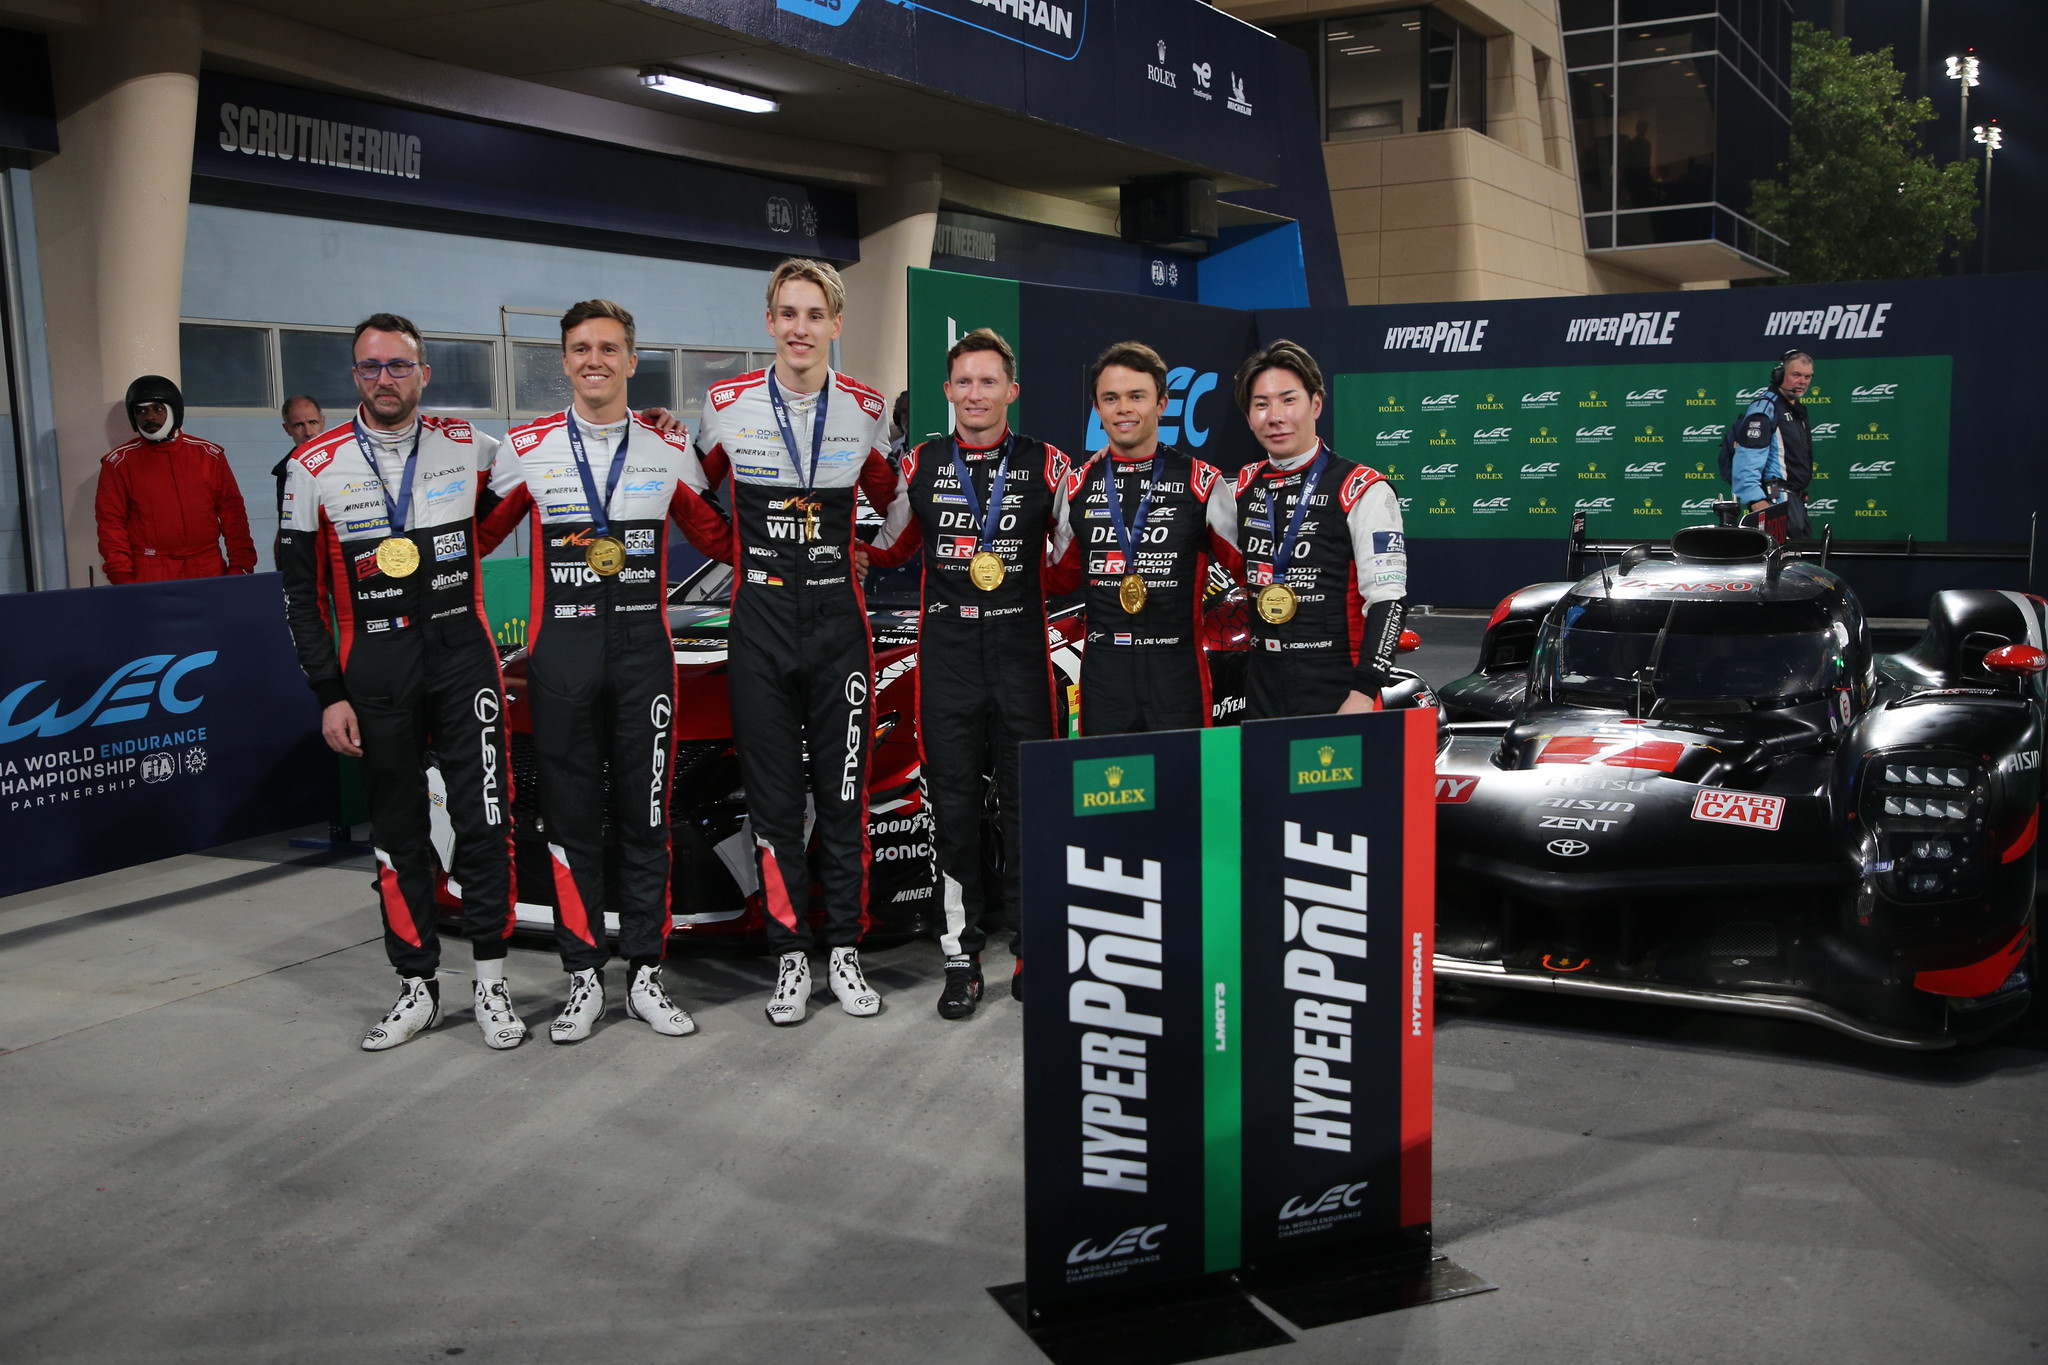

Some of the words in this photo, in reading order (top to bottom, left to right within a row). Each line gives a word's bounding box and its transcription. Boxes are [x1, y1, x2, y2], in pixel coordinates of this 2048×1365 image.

[970, 0, 1073, 39] HRAIN
[1147, 64, 1177, 88] ROLEX
[1227, 100, 1252, 116] MICHELIN
[219, 102, 421, 179] SCRUTINEERING
[934, 223, 996, 261] UTINEERING
[1566, 312, 1680, 346] HYPERPOLE
[1764, 303, 1892, 340] HYPERPOLE
[1384, 319, 1489, 353] HYPERPOLE
[713, 390, 736, 402] OMP
[1522, 392, 1561, 402] WEC
[1626, 389, 1667, 400] WEC
[1852, 384, 1898, 396] WEC
[863, 399, 882, 412] OMP
[1422, 394, 1459, 405] WEC
[448, 430, 471, 440] OMP
[1376, 430, 1413, 440] WEC
[1474, 428, 1512, 438] WEC
[1576, 426, 1616, 436] WEC
[1683, 425, 1725, 435] WEC
[514, 434, 539, 447] OMP
[306, 451, 329, 469] OMP
[735, 448, 766, 457] MINERVA
[431, 466, 465, 477] LEXUS
[737, 467, 777, 476] GOODYEAR
[1421, 463, 1459, 474] WEC
[1521, 462, 1560, 473] WEC
[1625, 462, 1667, 473] WEC
[1850, 461, 1896, 472] WEC
[1685, 472, 1715, 480] ROLEX
[545, 487, 578, 495] MINERVA
[344, 500, 380, 512] MINERVA
[768, 501, 784, 510] 88
[1473, 497, 1511, 507] WEC
[1575, 497, 1615, 508] WEC
[349, 519, 390, 529] GOODYEA
[939, 511, 1017, 531] DENO
[436, 542, 466, 556] DORIA
[626, 541, 654, 549] DORIA
[938, 544, 974, 557] GR
[937, 563, 969, 572] RACIN
[1091, 560, 1125, 572] GR
[1136, 567, 1171, 575] acing
[431, 571, 468, 590] glinche
[619, 567, 656, 582] glinche
[747, 572, 767, 581] OMP
[1247, 570, 1273, 585] GR
[1620, 579, 1752, 592] DENSO
[358, 591, 369, 600] La
[370, 588, 403, 599] Sarthe
[554, 607, 577, 616] OMP
[367, 621, 390, 631] OMP
[1383, 603, 1403, 657] KINSHUKAI
[878, 636, 918, 644] Sarthe
[1290, 641, 1333, 649] KOBAYASHI
[24, 747, 95, 772] WORLD
[100, 727, 207, 759] ENDURANCE
[841, 708, 862, 801] LEXUS
[1580, 737, 1645, 763] 7
[2006, 750, 2040, 773] AISIN
[1, 757, 136, 796] HAMPIONSHIP
[143, 757, 172, 779] FIA
[481, 726, 501, 826] LEXUS
[650, 731, 666, 827] LEXUS
[1298, 767, 1355, 785] ROLEX
[1545, 774, 1647, 793] FUJITSU
[11, 778, 136, 812] PARTNERSHIP
[1083, 788, 1146, 808] ROLEX
[1704, 793, 1777, 809] HYPER
[1537, 797, 1636, 813] AISIN
[1700, 802, 1775, 826] CAR
[1539, 816, 1618, 832] ZENT
[875, 843, 928, 862] SONIC
[891, 886, 933, 903] MINER
[1284, 820, 1368, 1153] HYPERPOLE
[1412, 931, 1423, 1037] HYPERCAR
[1067, 845, 1163, 1193] HYPERPOLE
[1215, 982, 1227, 1051] LMGT3
[1279, 1181, 1368, 1220] WEC
[1292, 1219, 1318, 1228] WORLD
[1319, 1210, 1362, 1224] ENDURANCE
[1279, 1223, 1333, 1238] CHAMPIONSHIP
[1067, 1223, 1168, 1264] WEC
[1081, 1262, 1111, 1273] WORLD
[1112, 1254, 1160, 1268] ENDURANCE
[1066, 1266, 1129, 1283] CHAMPIONSHIP
